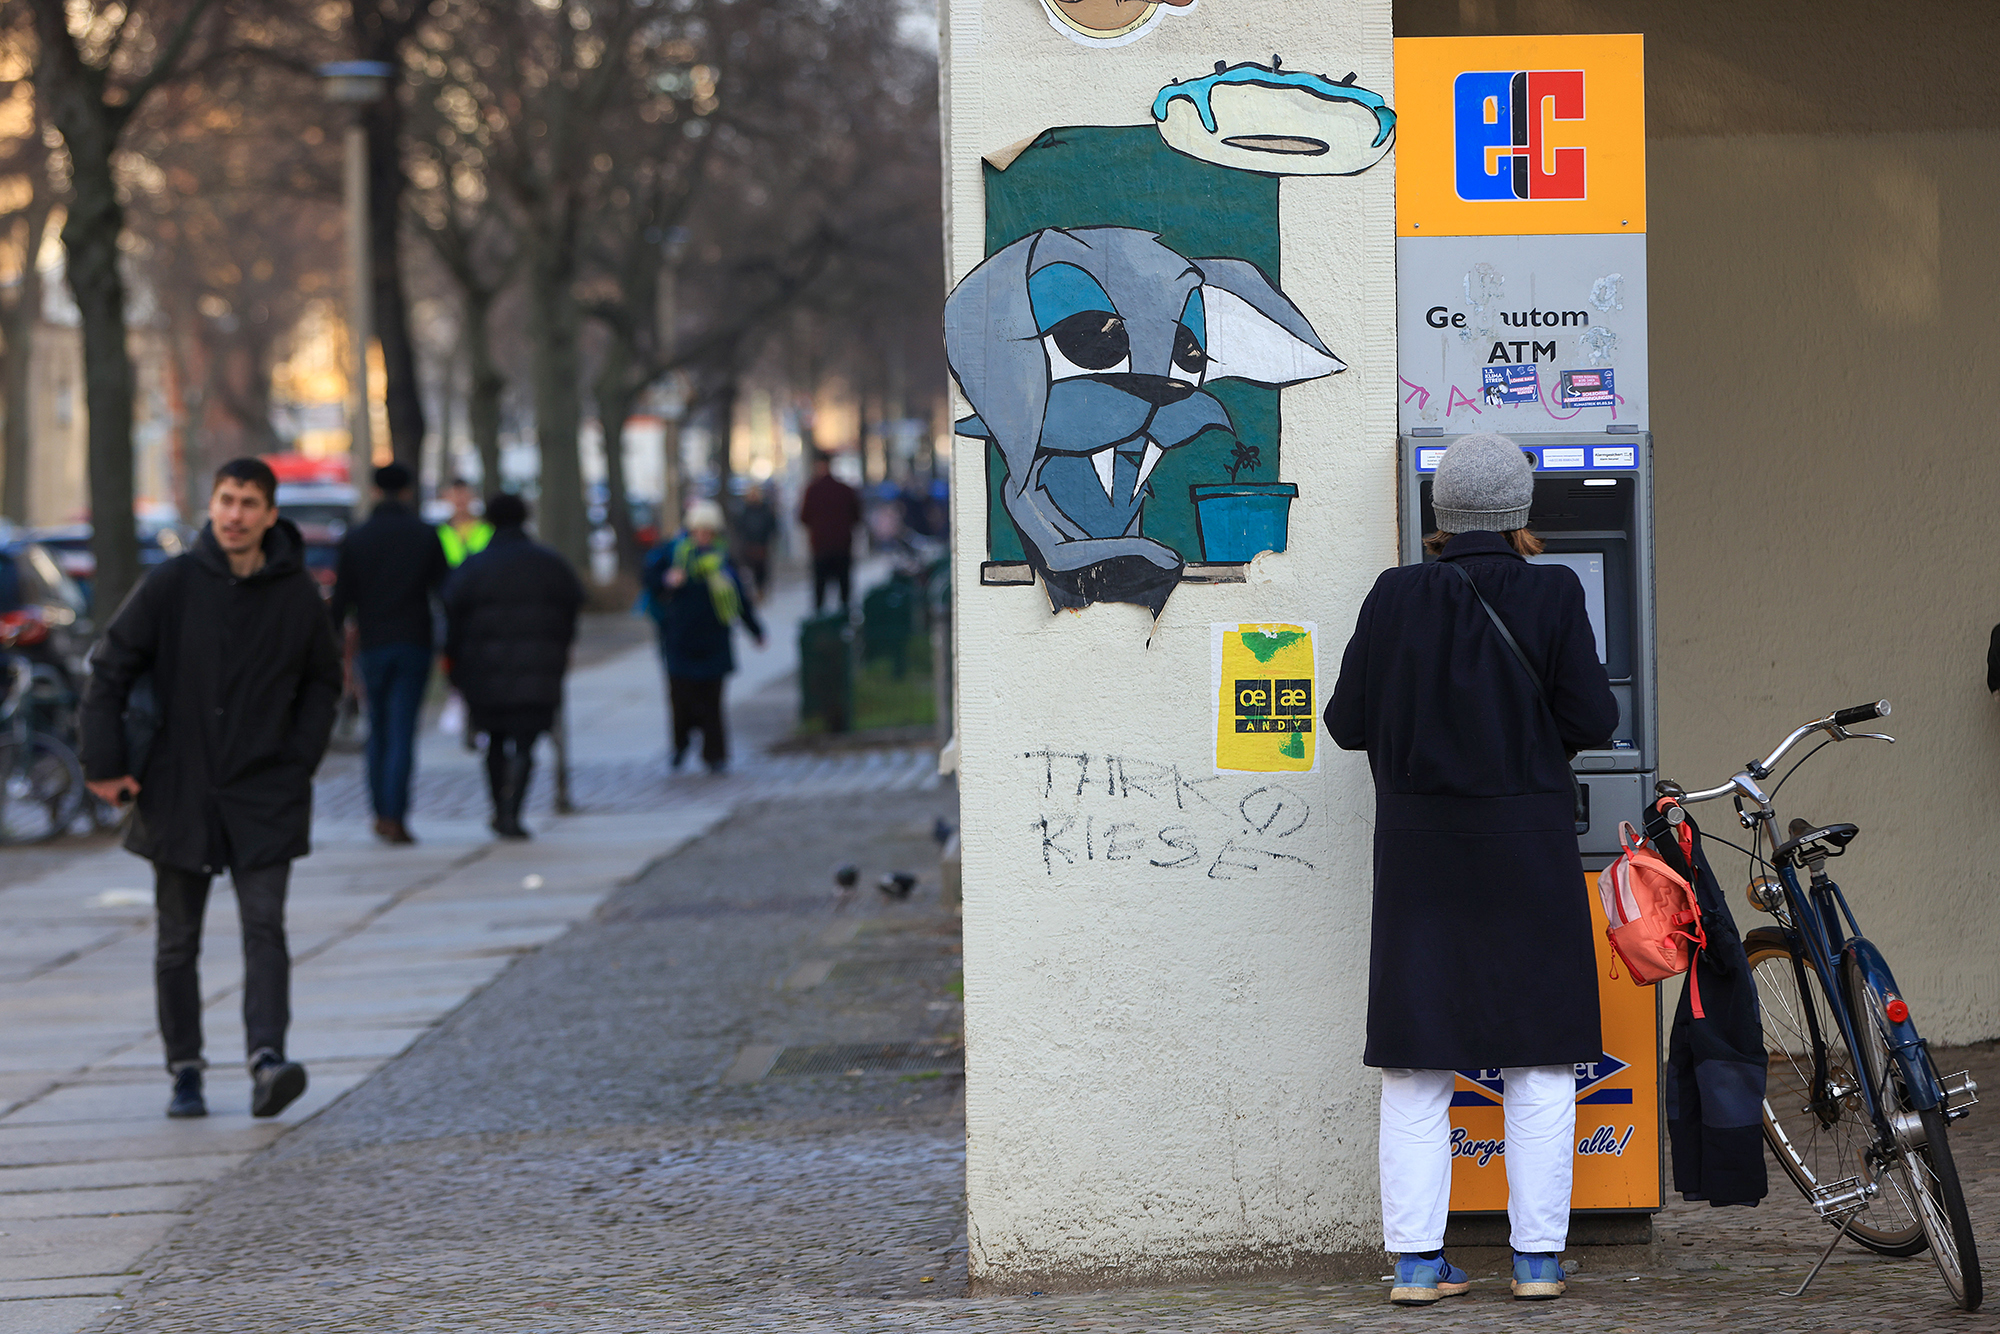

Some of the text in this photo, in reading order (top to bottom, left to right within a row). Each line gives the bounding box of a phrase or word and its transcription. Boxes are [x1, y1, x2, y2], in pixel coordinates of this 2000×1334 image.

[1487, 341, 1556, 363] ATM
[1246, 720, 1302, 731] ANDY
[1450, 1126, 1634, 1167] Barge alle!
